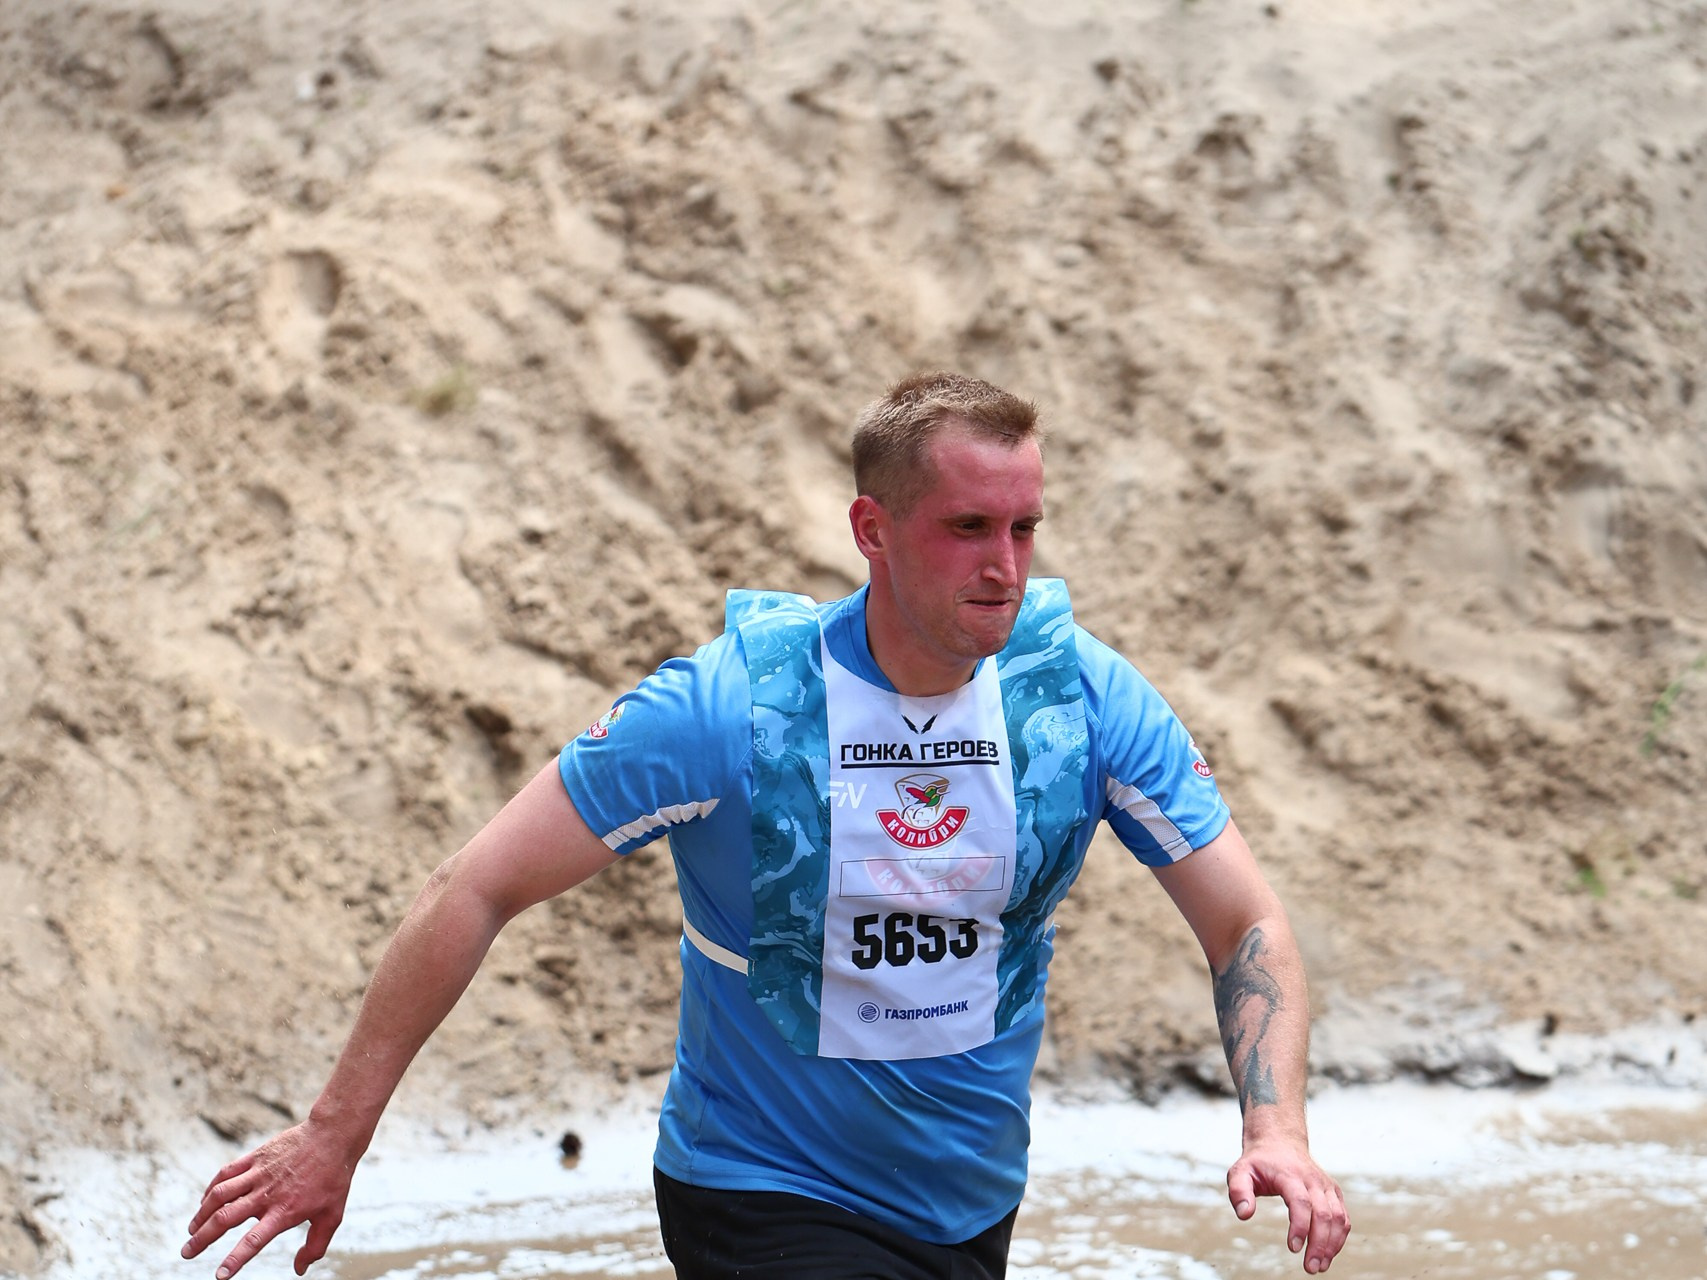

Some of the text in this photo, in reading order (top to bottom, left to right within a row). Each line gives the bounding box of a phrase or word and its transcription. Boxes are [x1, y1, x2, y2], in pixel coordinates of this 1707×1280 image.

[841, 740, 999, 761] ГОНКА ГЕРОЕВ
[851, 912, 980, 970] 5653
[884, 1000, 969, 1020] ГАЗПРОМБАНК
